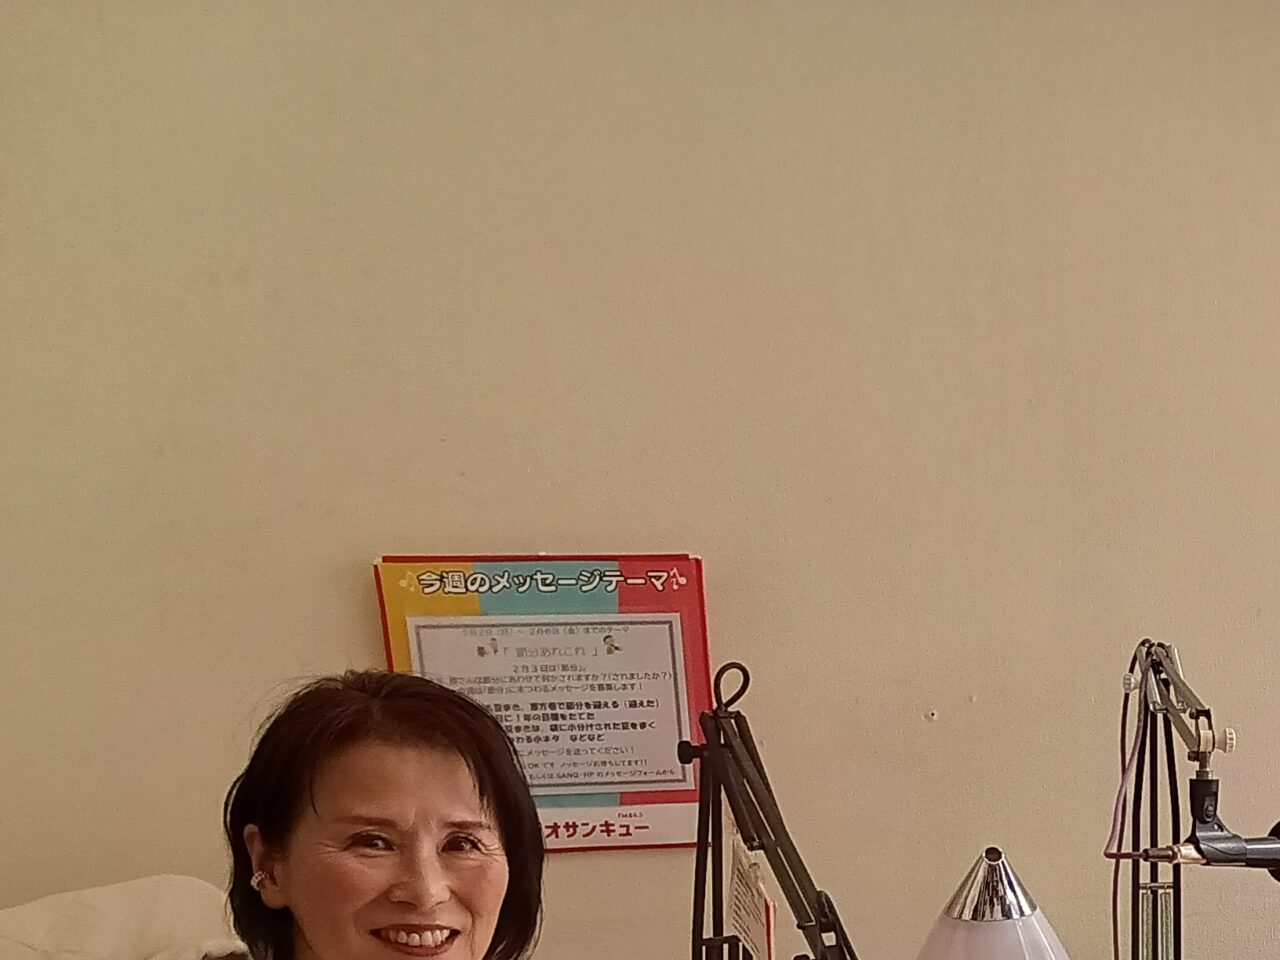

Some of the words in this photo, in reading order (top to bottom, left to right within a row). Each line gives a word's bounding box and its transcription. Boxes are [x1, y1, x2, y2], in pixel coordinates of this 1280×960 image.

[417, 569, 669, 594] 今週のメッセージテーマ
